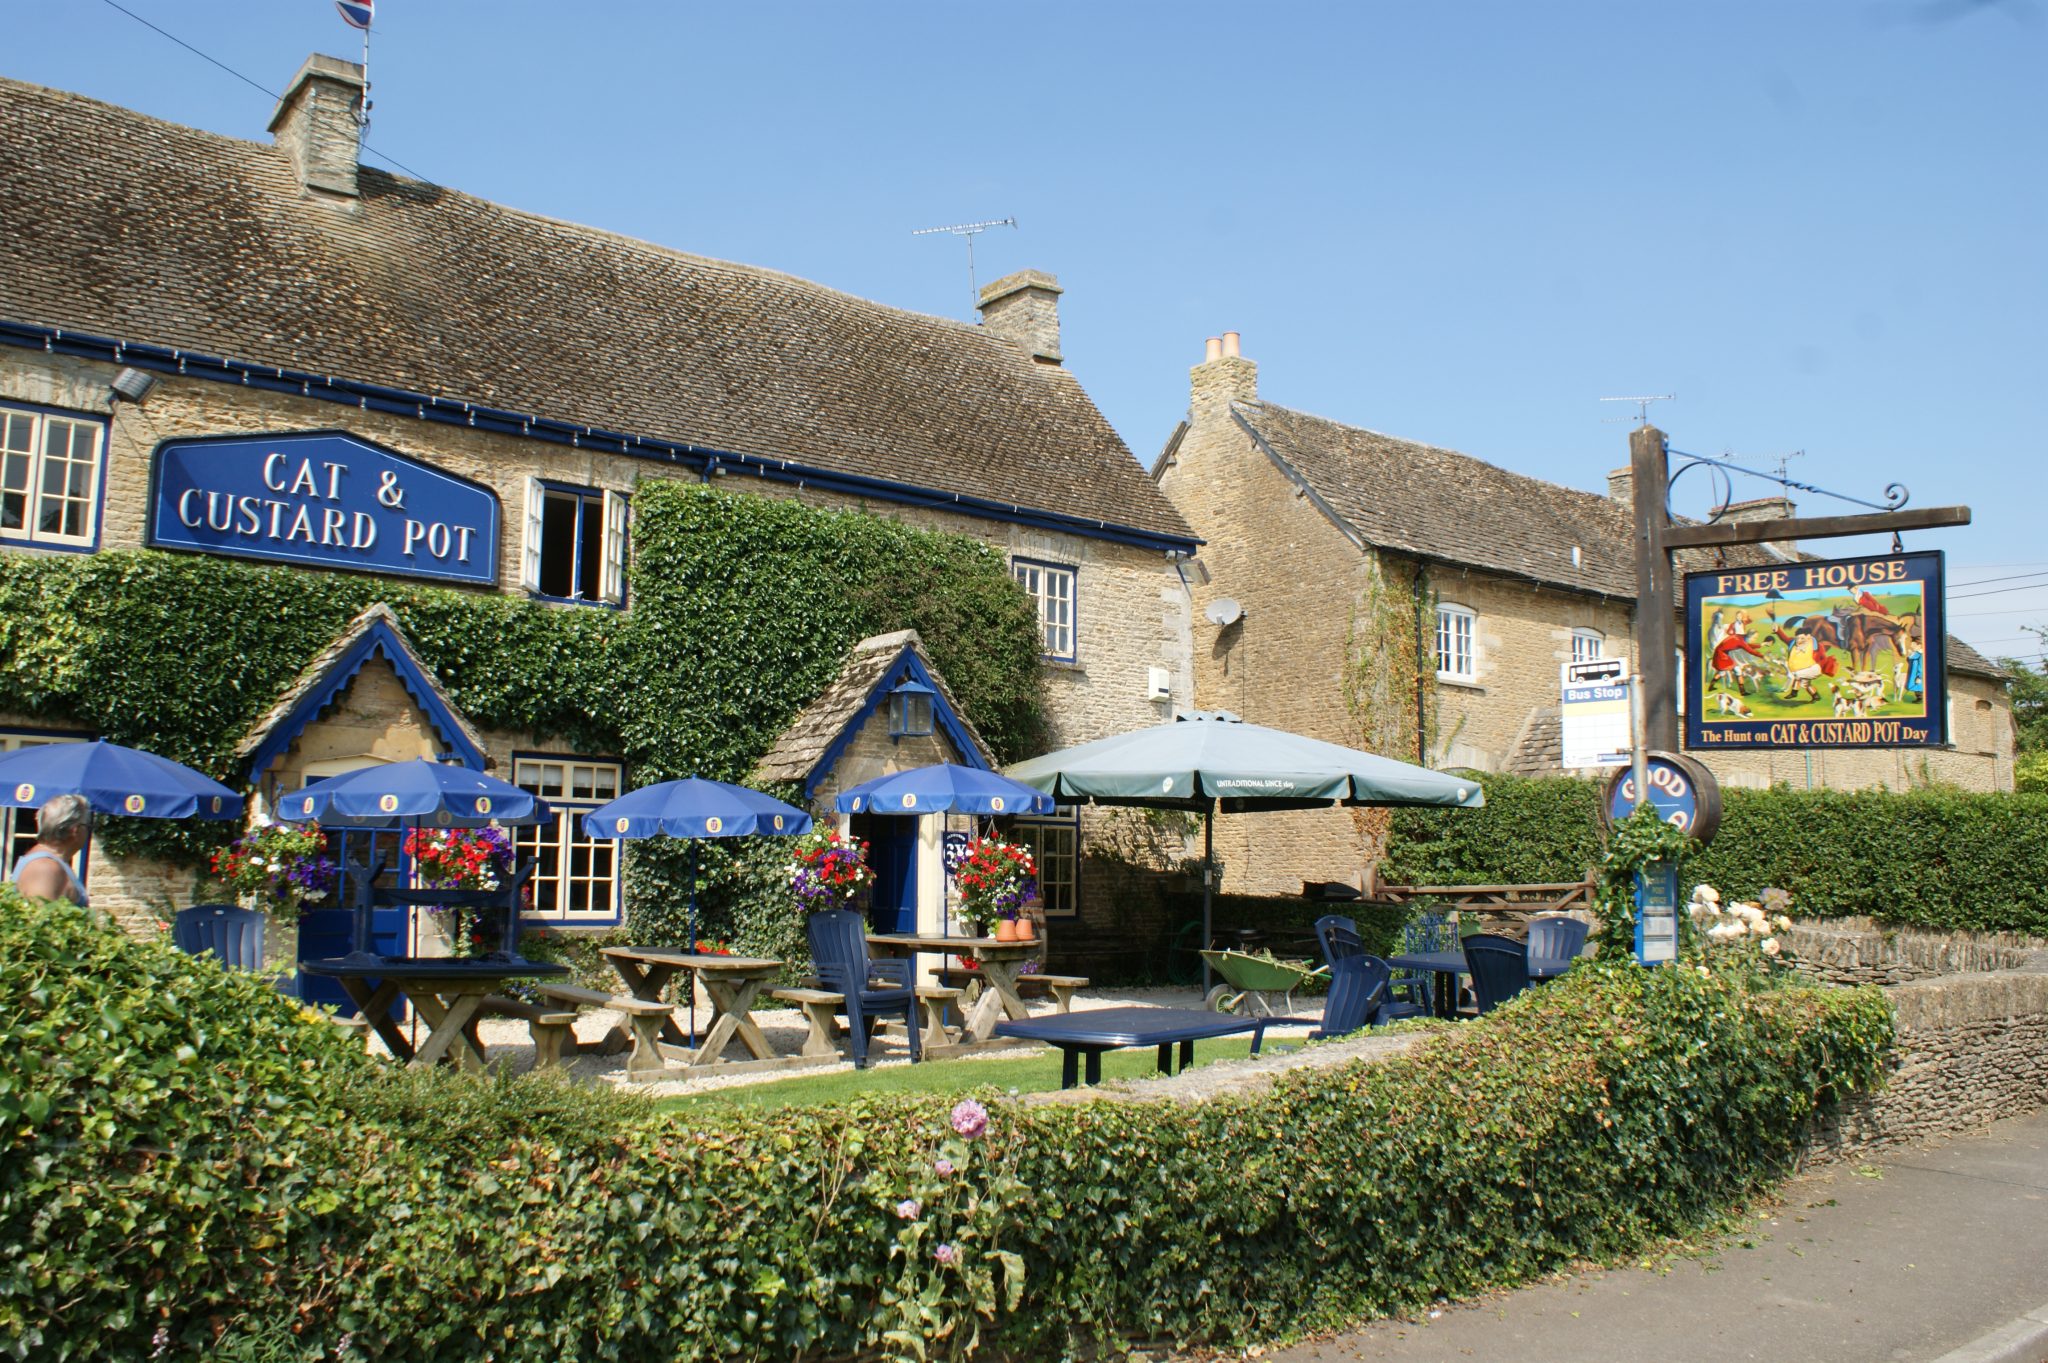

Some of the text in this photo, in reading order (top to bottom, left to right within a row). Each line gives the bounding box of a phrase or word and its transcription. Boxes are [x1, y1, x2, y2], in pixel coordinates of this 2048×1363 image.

[263, 453, 407, 510] CAT &
[178, 488, 477, 562] CUSTARD POT
[1717, 560, 1908, 594] FREE HOUSE
[1568, 687, 1623, 701] Bus Stop
[1701, 721, 1928, 744] The Hunt on CAT & CUSTARD POT Day
[1216, 779, 1265, 788] UNTRADITIONAL
[1265, 779, 1283, 788] SINCE
